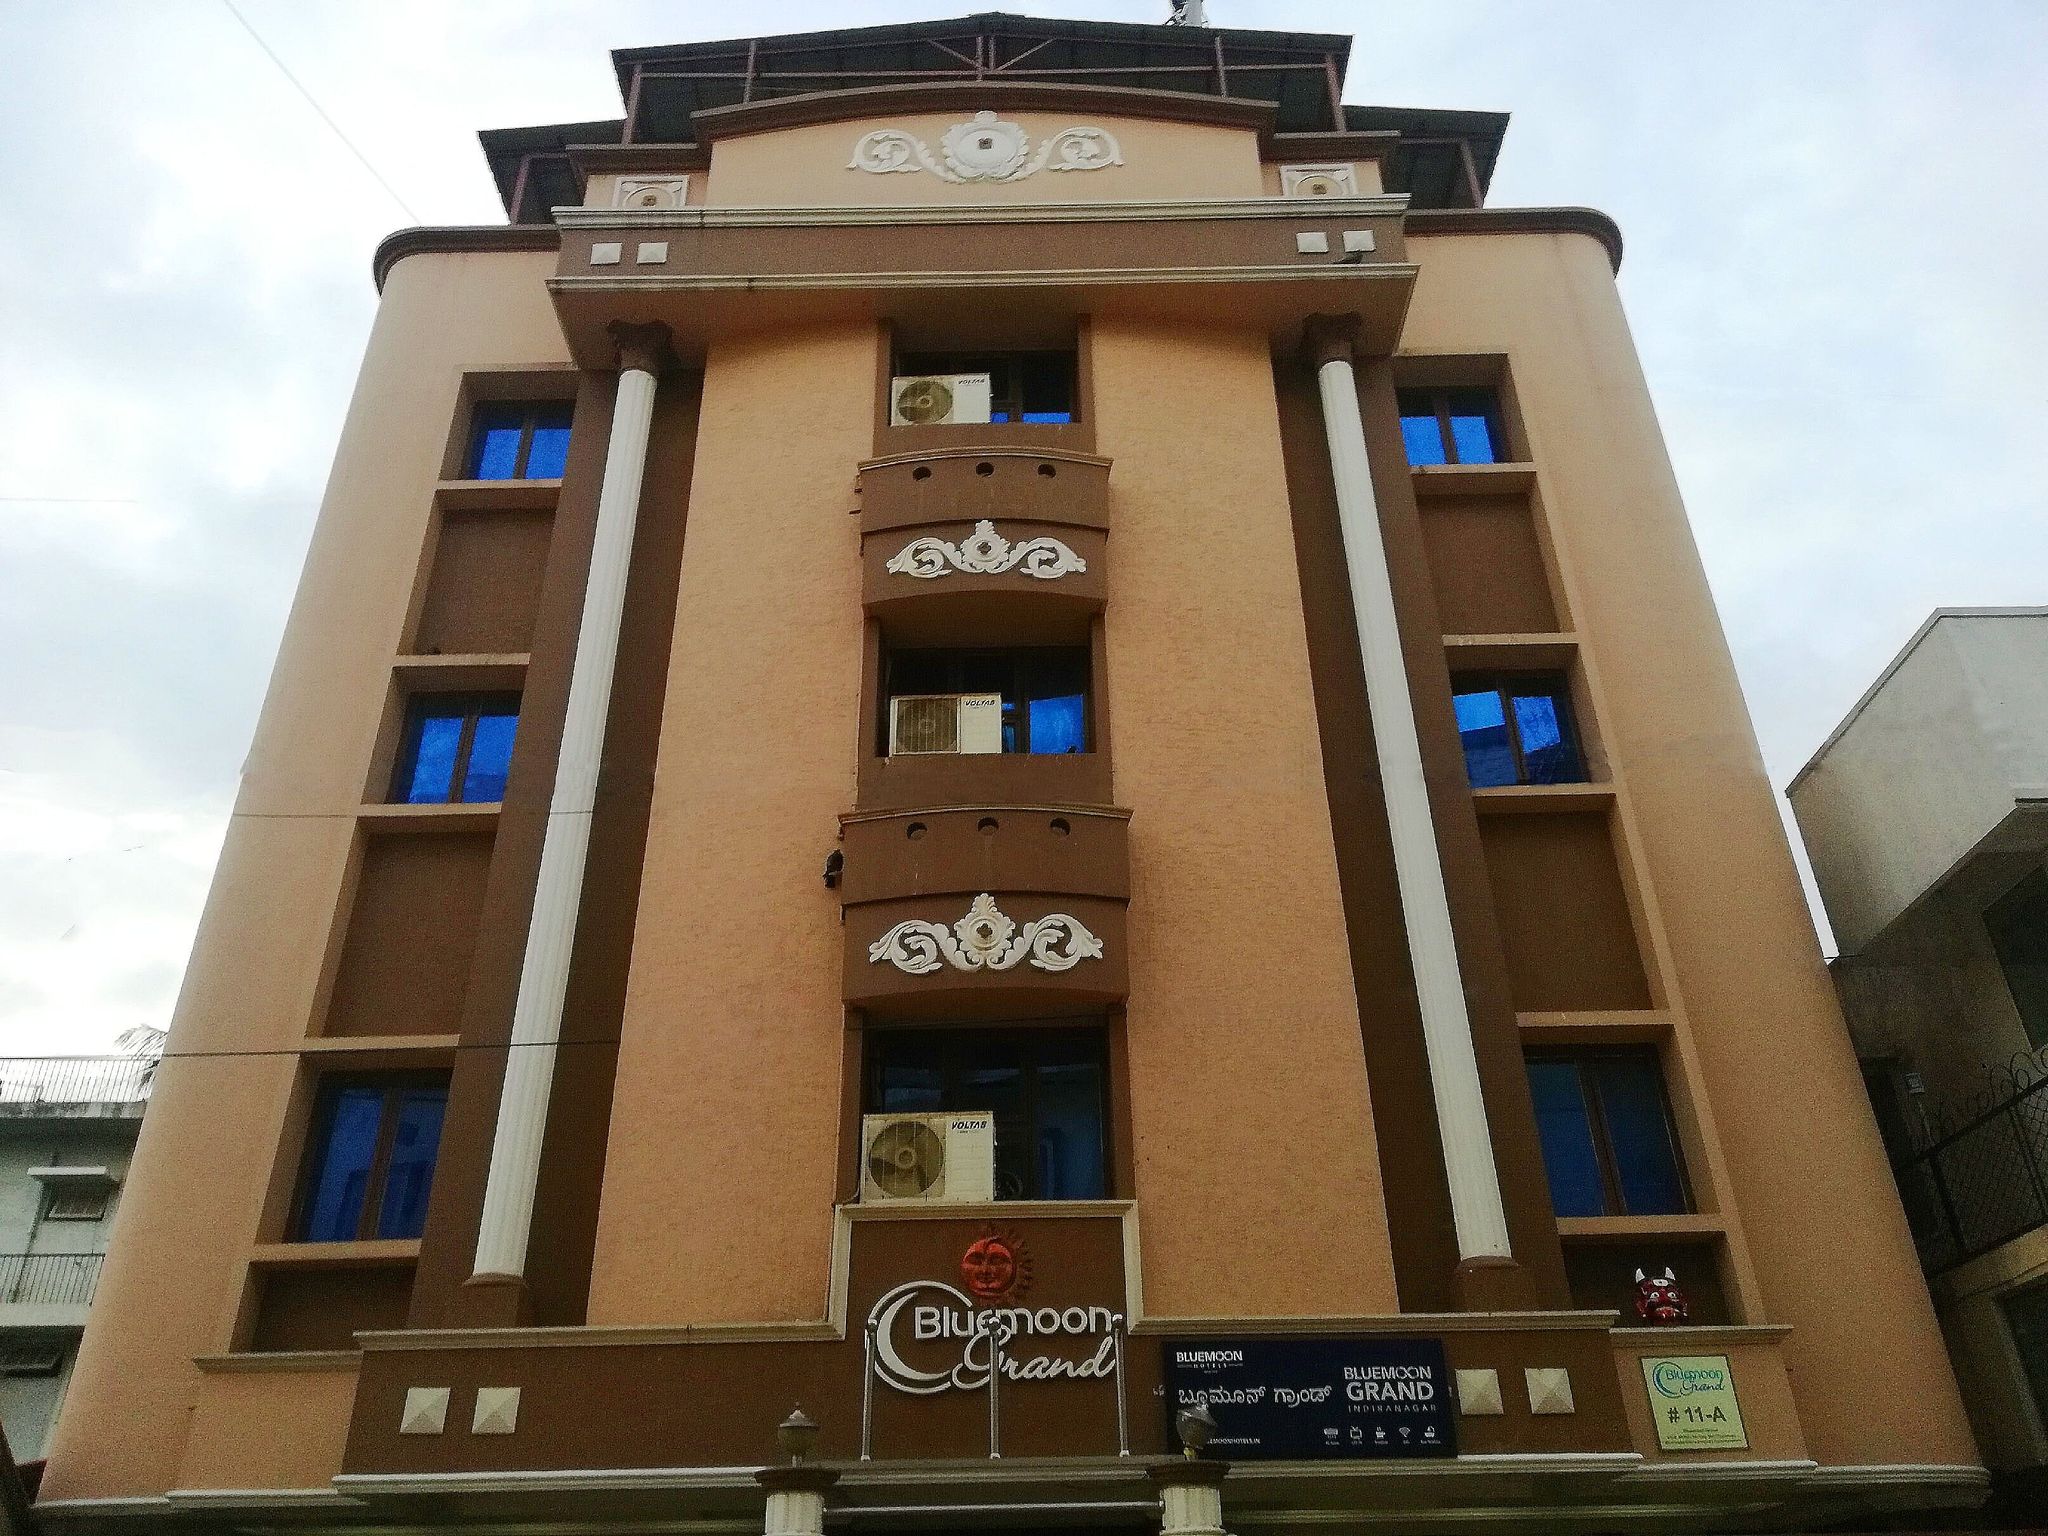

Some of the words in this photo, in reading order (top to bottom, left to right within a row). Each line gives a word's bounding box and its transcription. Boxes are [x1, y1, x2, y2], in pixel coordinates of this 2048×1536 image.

[952, 1121, 987, 1129] VOLTAS
[915, 1306, 1112, 1338] Bluemoon
[952, 1325, 1116, 1389] Grand
[1176, 1349, 1243, 1362] BLUEMOON
[1343, 1365, 1432, 1380] BLUEMOON
[1665, 1369, 1723, 1380] Bluemoon
[1346, 1381, 1434, 1401] GRAND
[1680, 1379, 1725, 1396] Grand
[1348, 1403, 1437, 1413] INDIRANAGAR
[1667, 1406, 1680, 1423] #
[1683, 1405, 1727, 1423] 11-A
